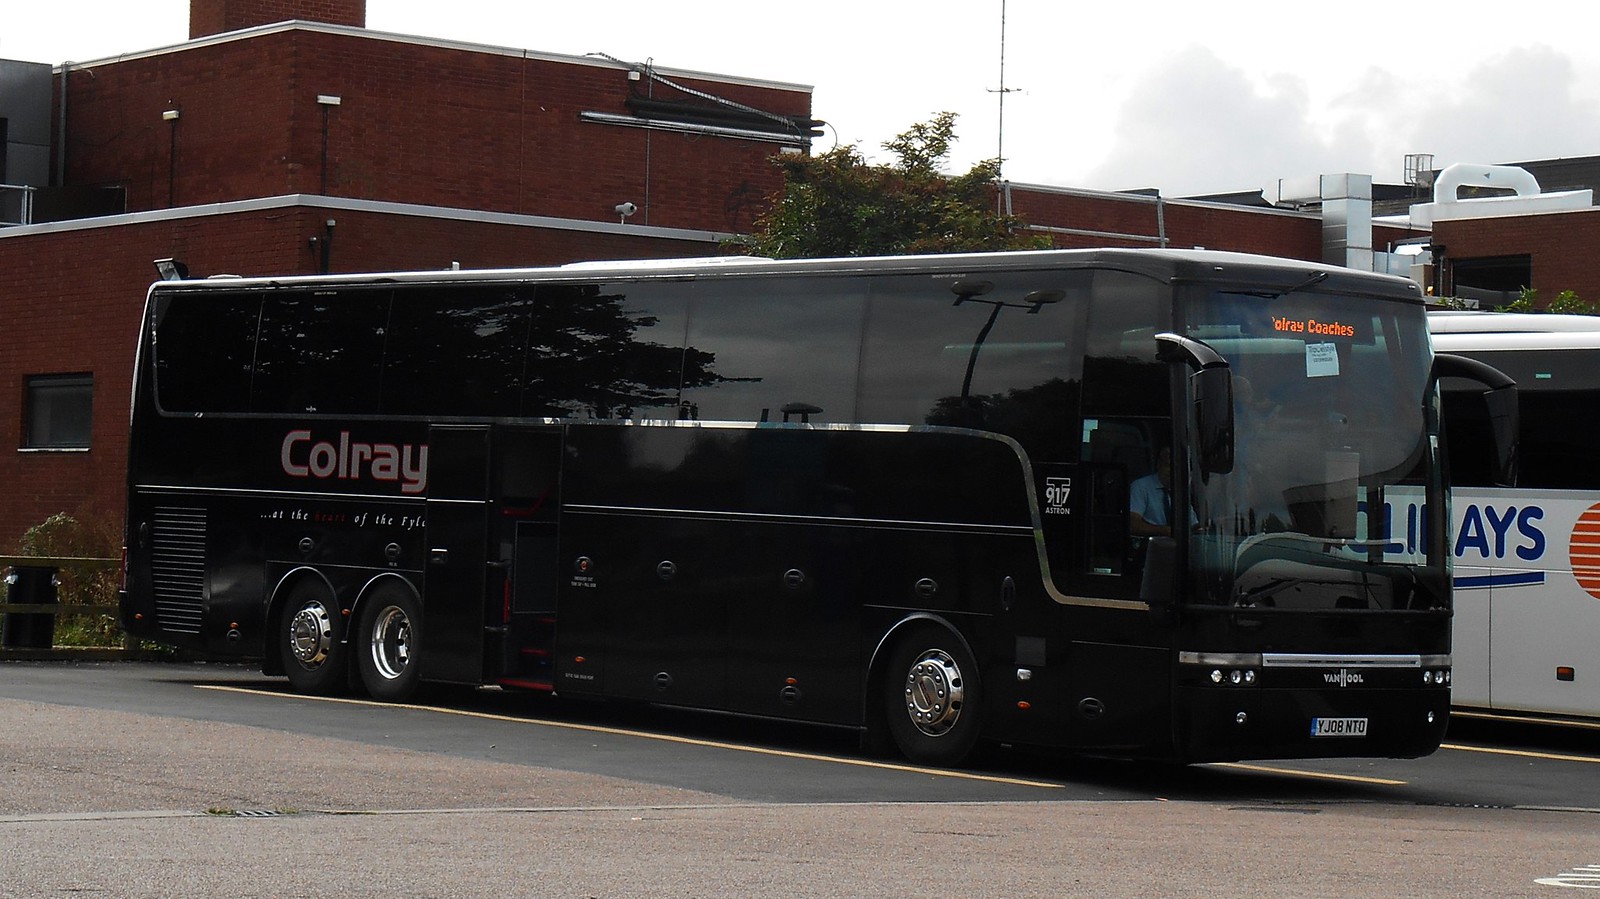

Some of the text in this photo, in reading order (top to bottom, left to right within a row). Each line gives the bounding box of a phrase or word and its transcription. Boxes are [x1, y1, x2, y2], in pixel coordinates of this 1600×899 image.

[1272, 316, 1355, 336] olray Coaches
[281, 429, 429, 494] Colray
[1046, 487, 1070, 504] 917
[291, 509, 309, 520] the
[354, 513, 368, 527] of
[375, 513, 394, 526] the
[1045, 507, 1070, 515] ASTRON
[1318, 720, 1366, 733] YJ08 NTO
